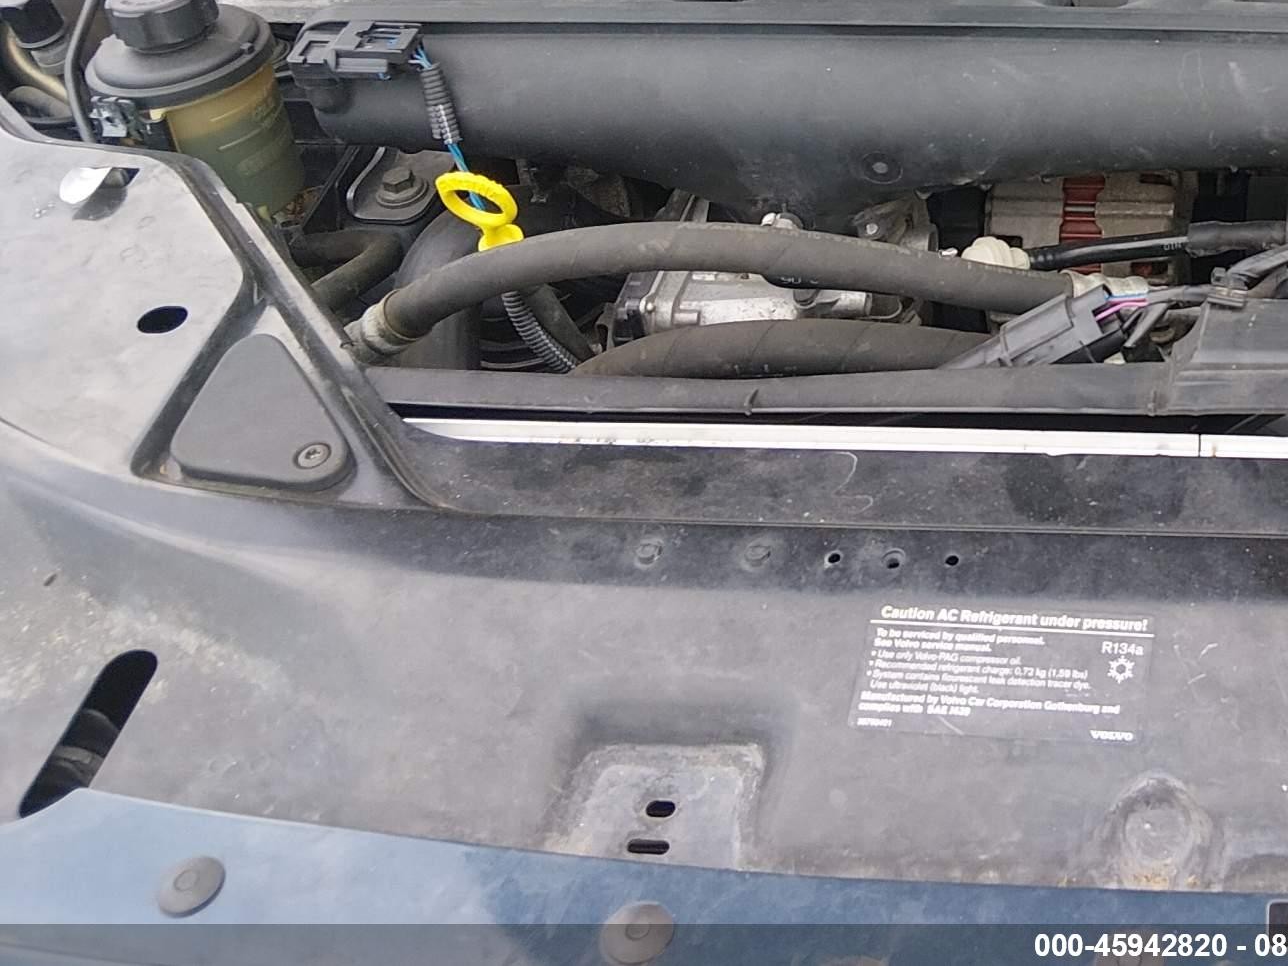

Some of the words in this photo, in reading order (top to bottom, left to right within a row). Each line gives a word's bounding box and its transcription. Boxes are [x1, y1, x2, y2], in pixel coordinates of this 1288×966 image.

[882, 605, 934, 620] Caution
[937, 608, 958, 622] AC
[961, 610, 1039, 627] Refrigerant
[1040, 615, 1080, 628] under
[1082, 616, 1148, 633] pressure!
[874, 638, 892, 646] See
[895, 639, 919, 648] Volvo
[922, 641, 953, 650] service
[877, 627, 886, 637] To
[889, 628, 900, 638] be
[903, 629, 940, 640] serviced
[943, 631, 953, 641] by
[955, 632, 994, 644] qualified
[1102, 642, 1143, 655] R134a
[879, 649, 893, 658] Use
[896, 650, 913, 659] only
[915, 651, 957, 662] Volvo-PAG
[960, 654, 1007, 666] compressor
[1010, 657, 1021, 666] oil.
[875, 659, 936, 671] Recommended
[938, 663, 980, 674] refrigerant
[982, 665, 1012, 676] charge:
[1035, 668, 1046, 678] kg
[870, 679, 887, 688] Use
[888, 681, 928, 691] ultraviolet
[930, 683, 957, 692] (black)
[959, 685, 979, 695] light.
[872, 669, 903, 680] System
[905, 671, 939, 682] contains
[989, 676, 1005, 686] leak
[1008, 677, 1045, 688] detection
[1048, 680, 1071, 689] tracer
[1074, 681, 1091, 691] dye.
[858, 701, 900, 712] complies
[903, 704, 922, 713] with
[927, 705, 947, 715] SAE
[861, 691, 925, 704] Manufactured
[927, 695, 938, 704] by
[940, 696, 965, 706] Volvo
[968, 697, 984, 707] Car
[986, 698, 1042, 710] Corporation
[1044, 702, 1099, 714] Gothenburg
[1102, 705, 1120, 715] and
[1091, 730, 1133, 741] VOLVO
